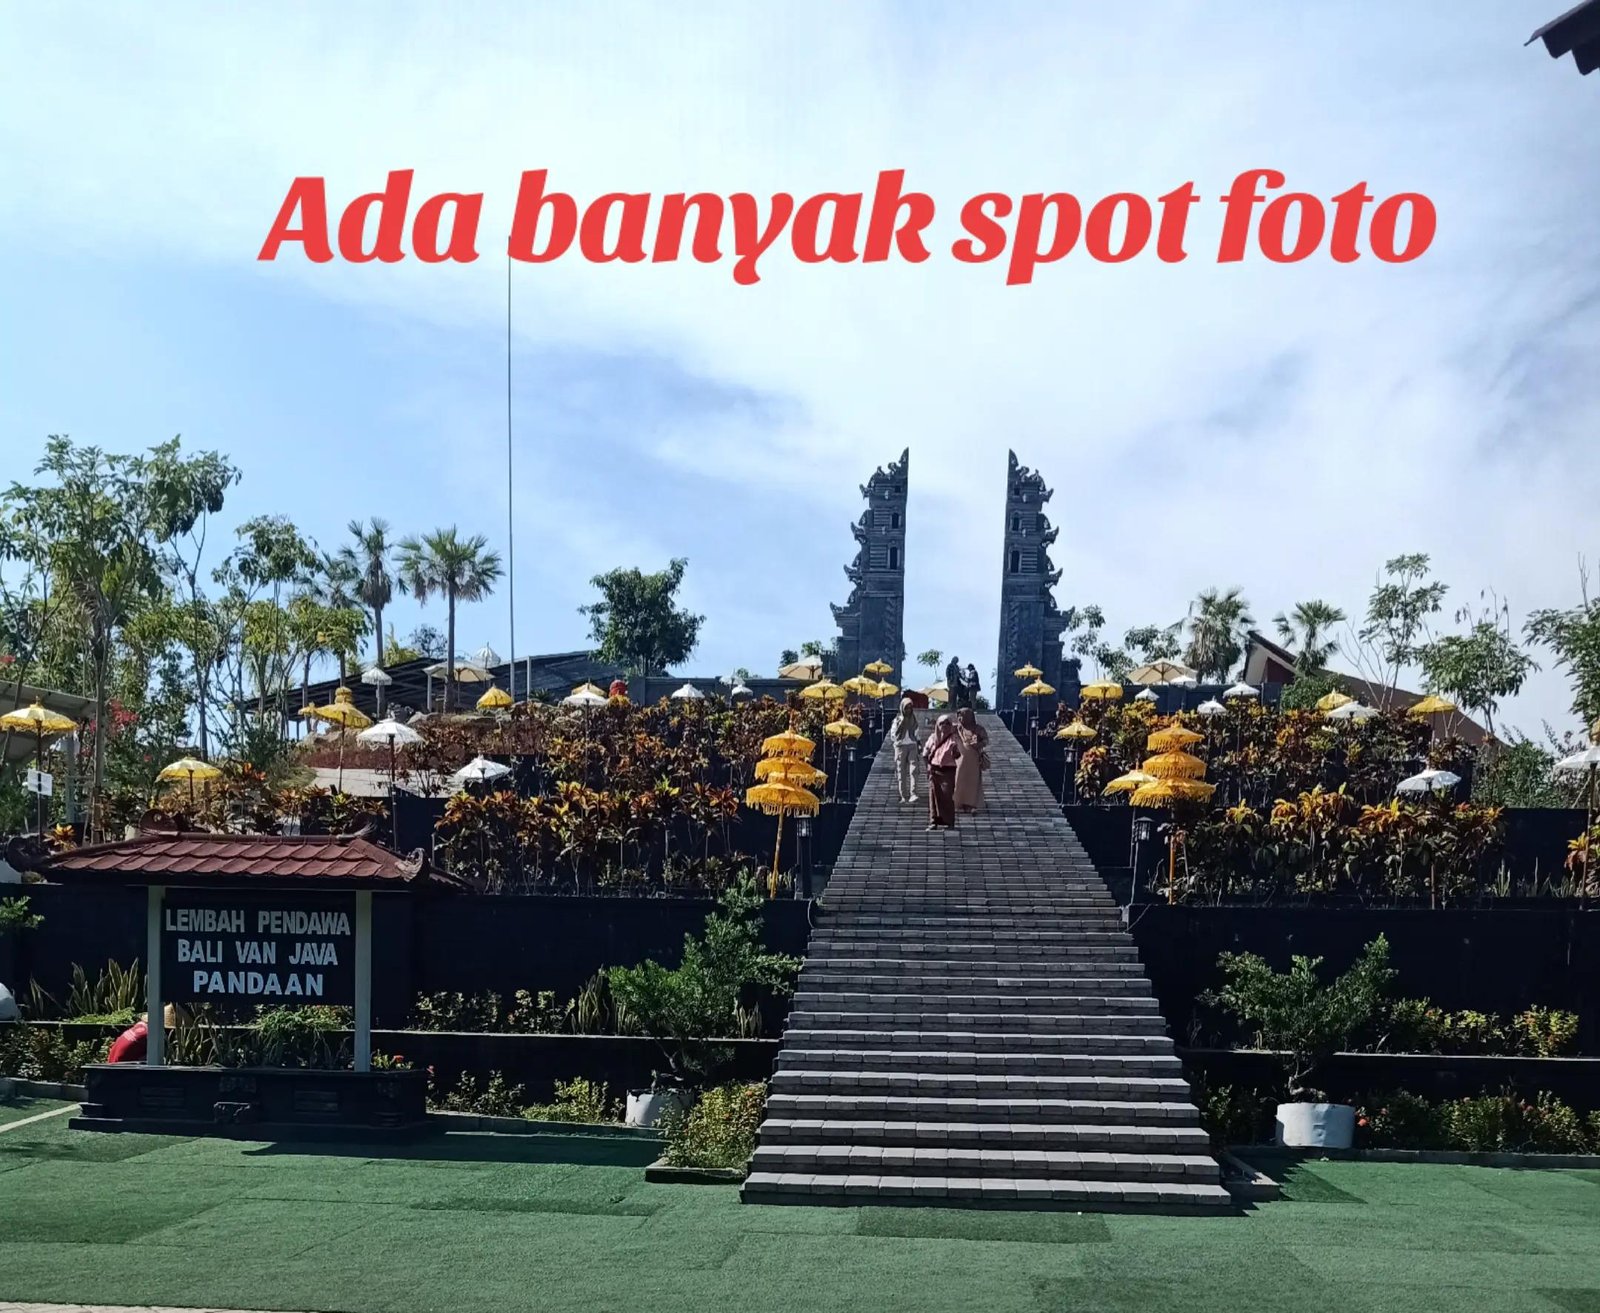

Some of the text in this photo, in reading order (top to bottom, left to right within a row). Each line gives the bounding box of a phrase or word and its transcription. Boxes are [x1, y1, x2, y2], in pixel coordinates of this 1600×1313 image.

[165, 908, 351, 936] LEMBAH PENDAWA
[177, 938, 338, 966] BALI VAN JAVA
[193, 970, 323, 996] PANDAAN
